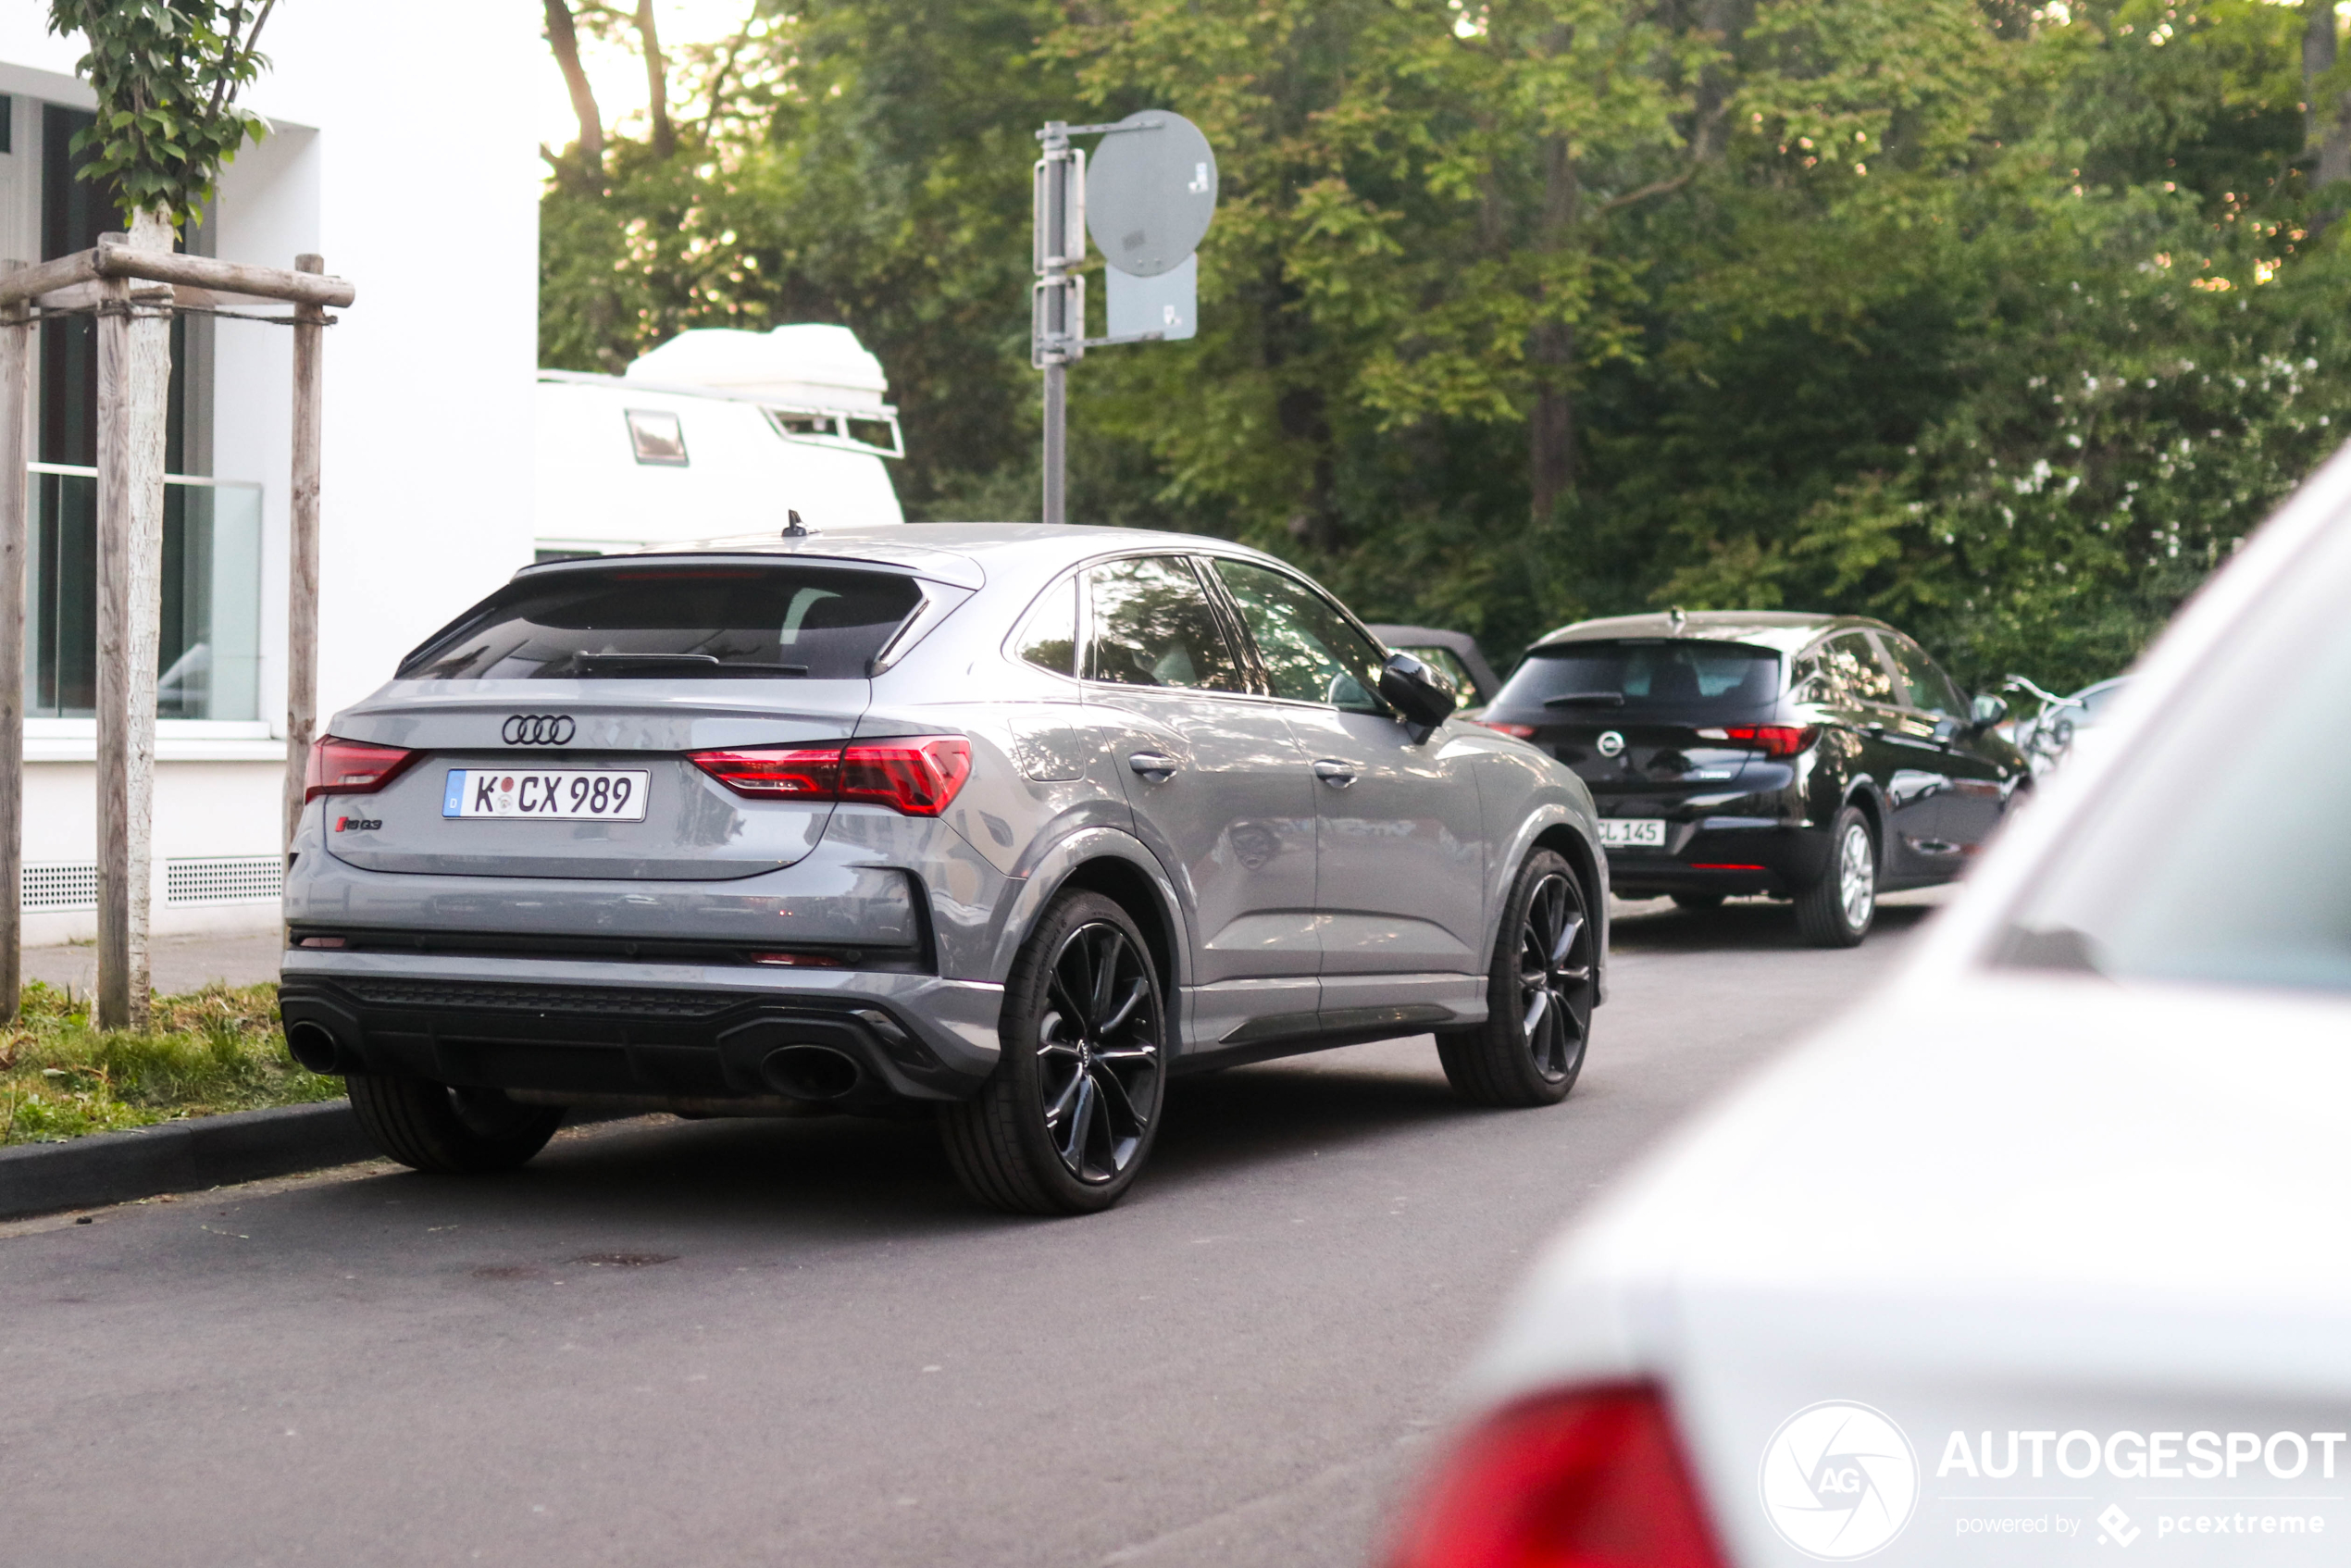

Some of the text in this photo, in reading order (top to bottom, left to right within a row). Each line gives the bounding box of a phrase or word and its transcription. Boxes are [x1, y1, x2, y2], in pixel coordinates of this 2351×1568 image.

[475, 776, 631, 813] K CX 989
[449, 798, 457, 809] D
[1623, 823, 1656, 840] 145
